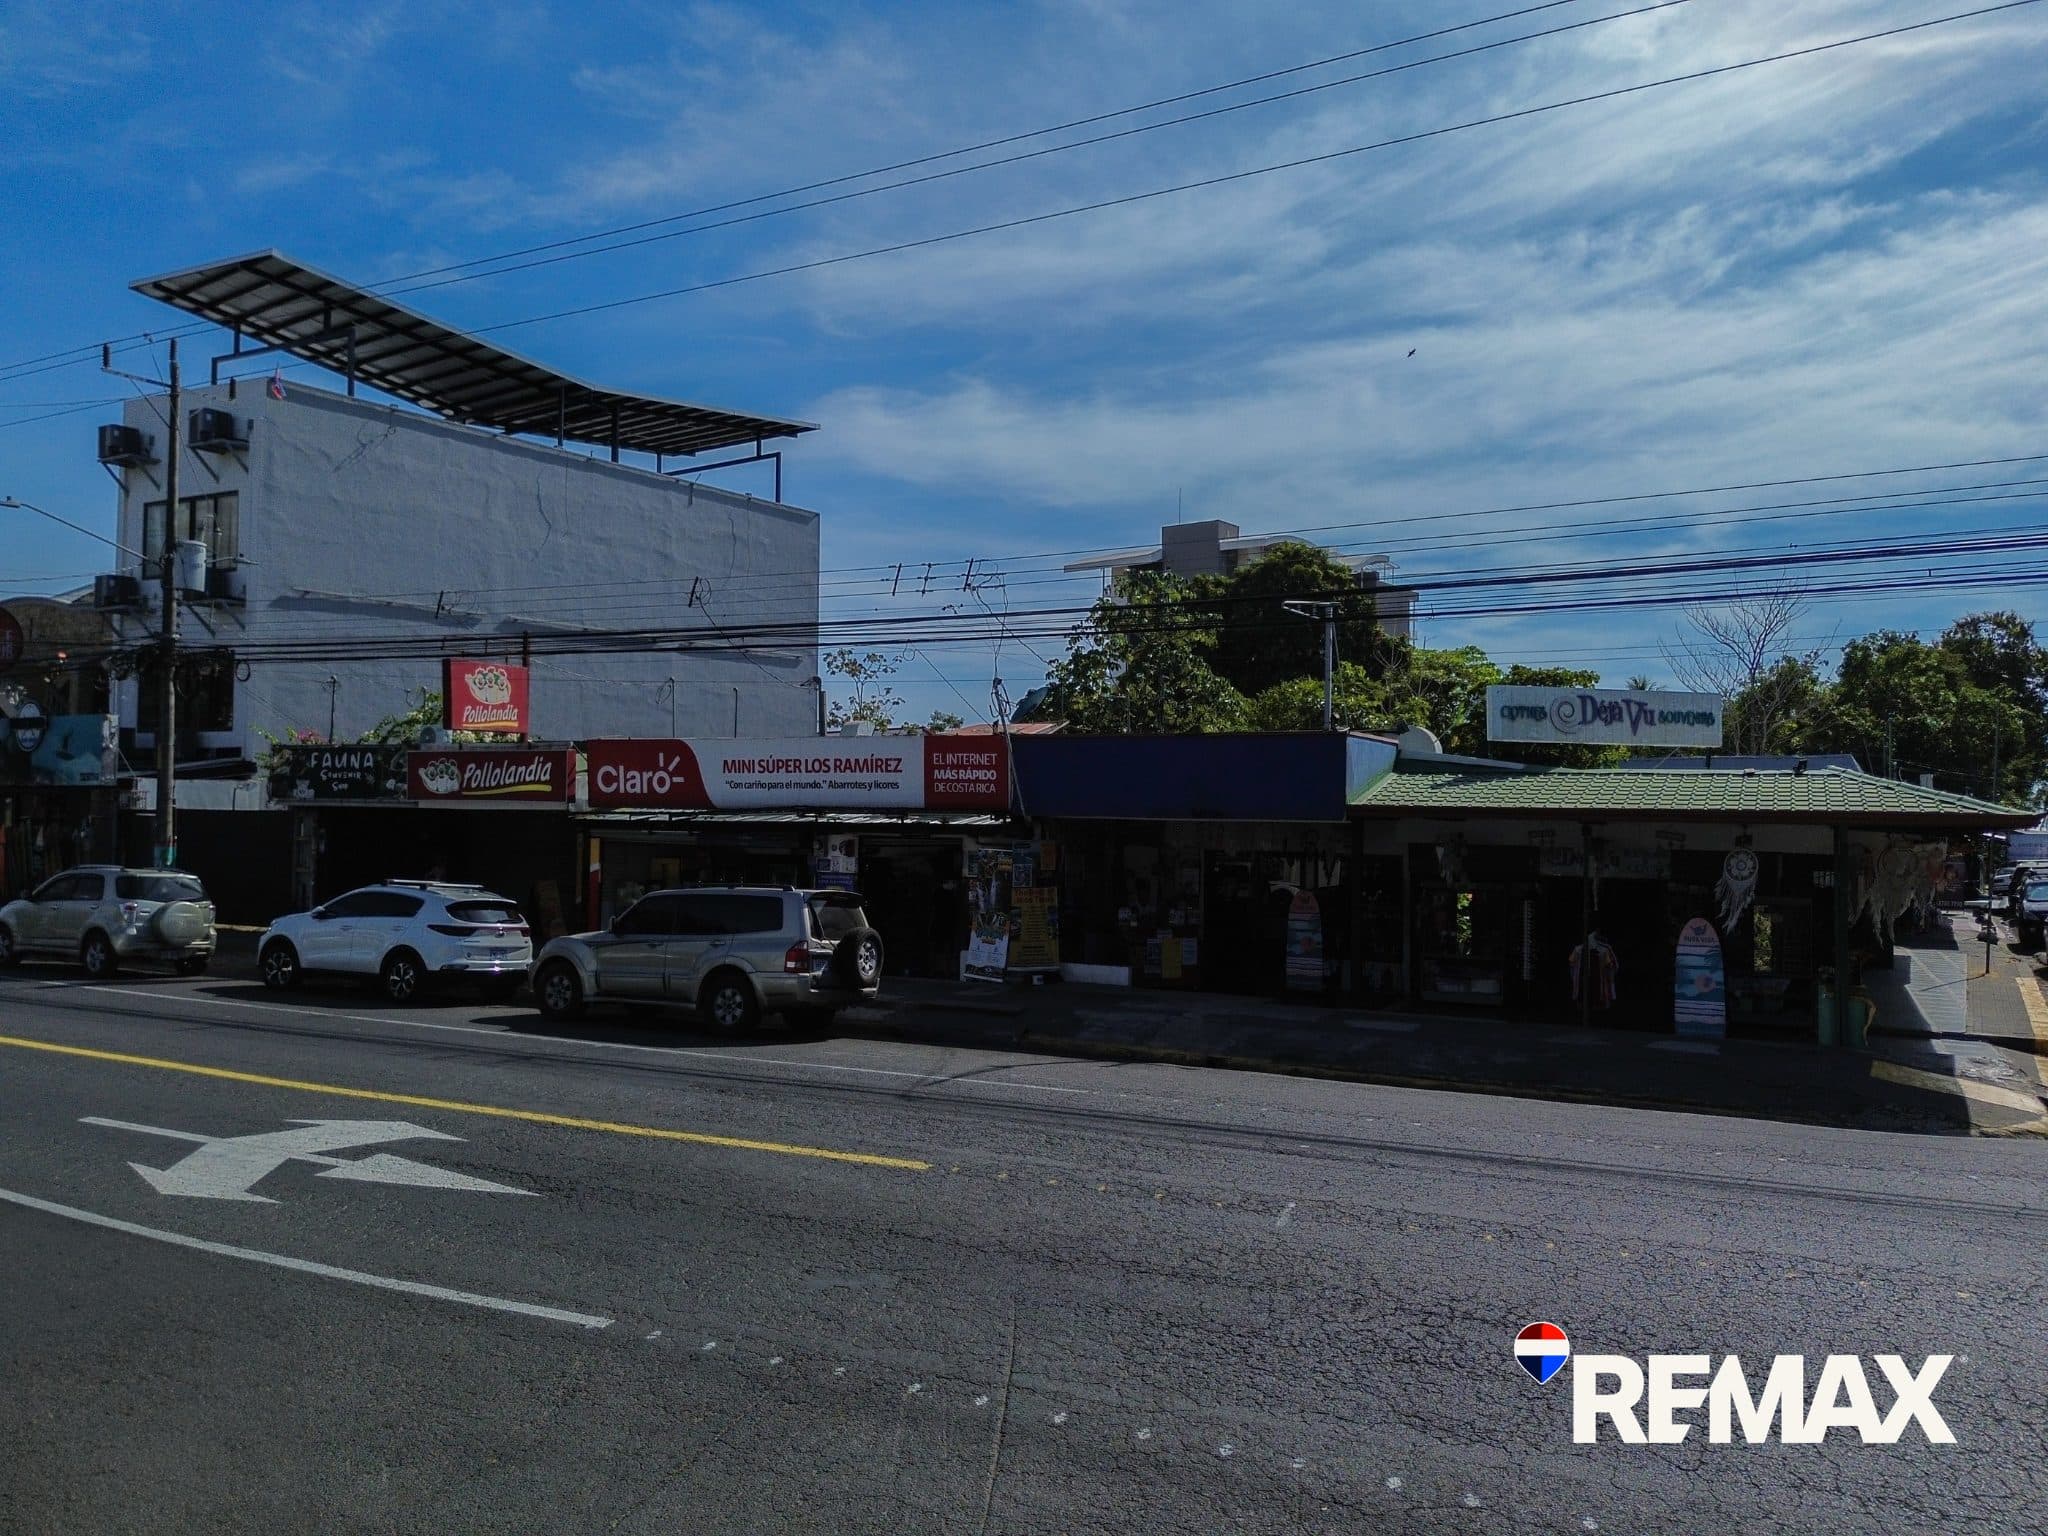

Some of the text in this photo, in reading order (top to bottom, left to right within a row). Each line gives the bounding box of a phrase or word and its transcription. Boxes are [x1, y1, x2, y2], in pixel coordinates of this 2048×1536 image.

[463, 704, 518, 723] Pollolandia
[1621, 699, 1658, 736] Vu
[311, 752, 374, 768] FAUNA
[723, 753, 903, 774] MINI SÚPER LOS RAMÍREZ
[933, 753, 997, 765] EL INTERNET
[462, 755, 552, 789] Pollolandia
[597, 764, 671, 794] Claro
[934, 766, 997, 780] MÁS RÁPIDO
[744, 779, 767, 790] cariño
[767, 782, 785, 792] para
[785, 780, 793, 790] el
[827, 780, 867, 790] Abarrotes
[867, 783, 873, 792] y
[874, 779, 900, 790] licores
[934, 783, 997, 794] DE COSTA RICA
